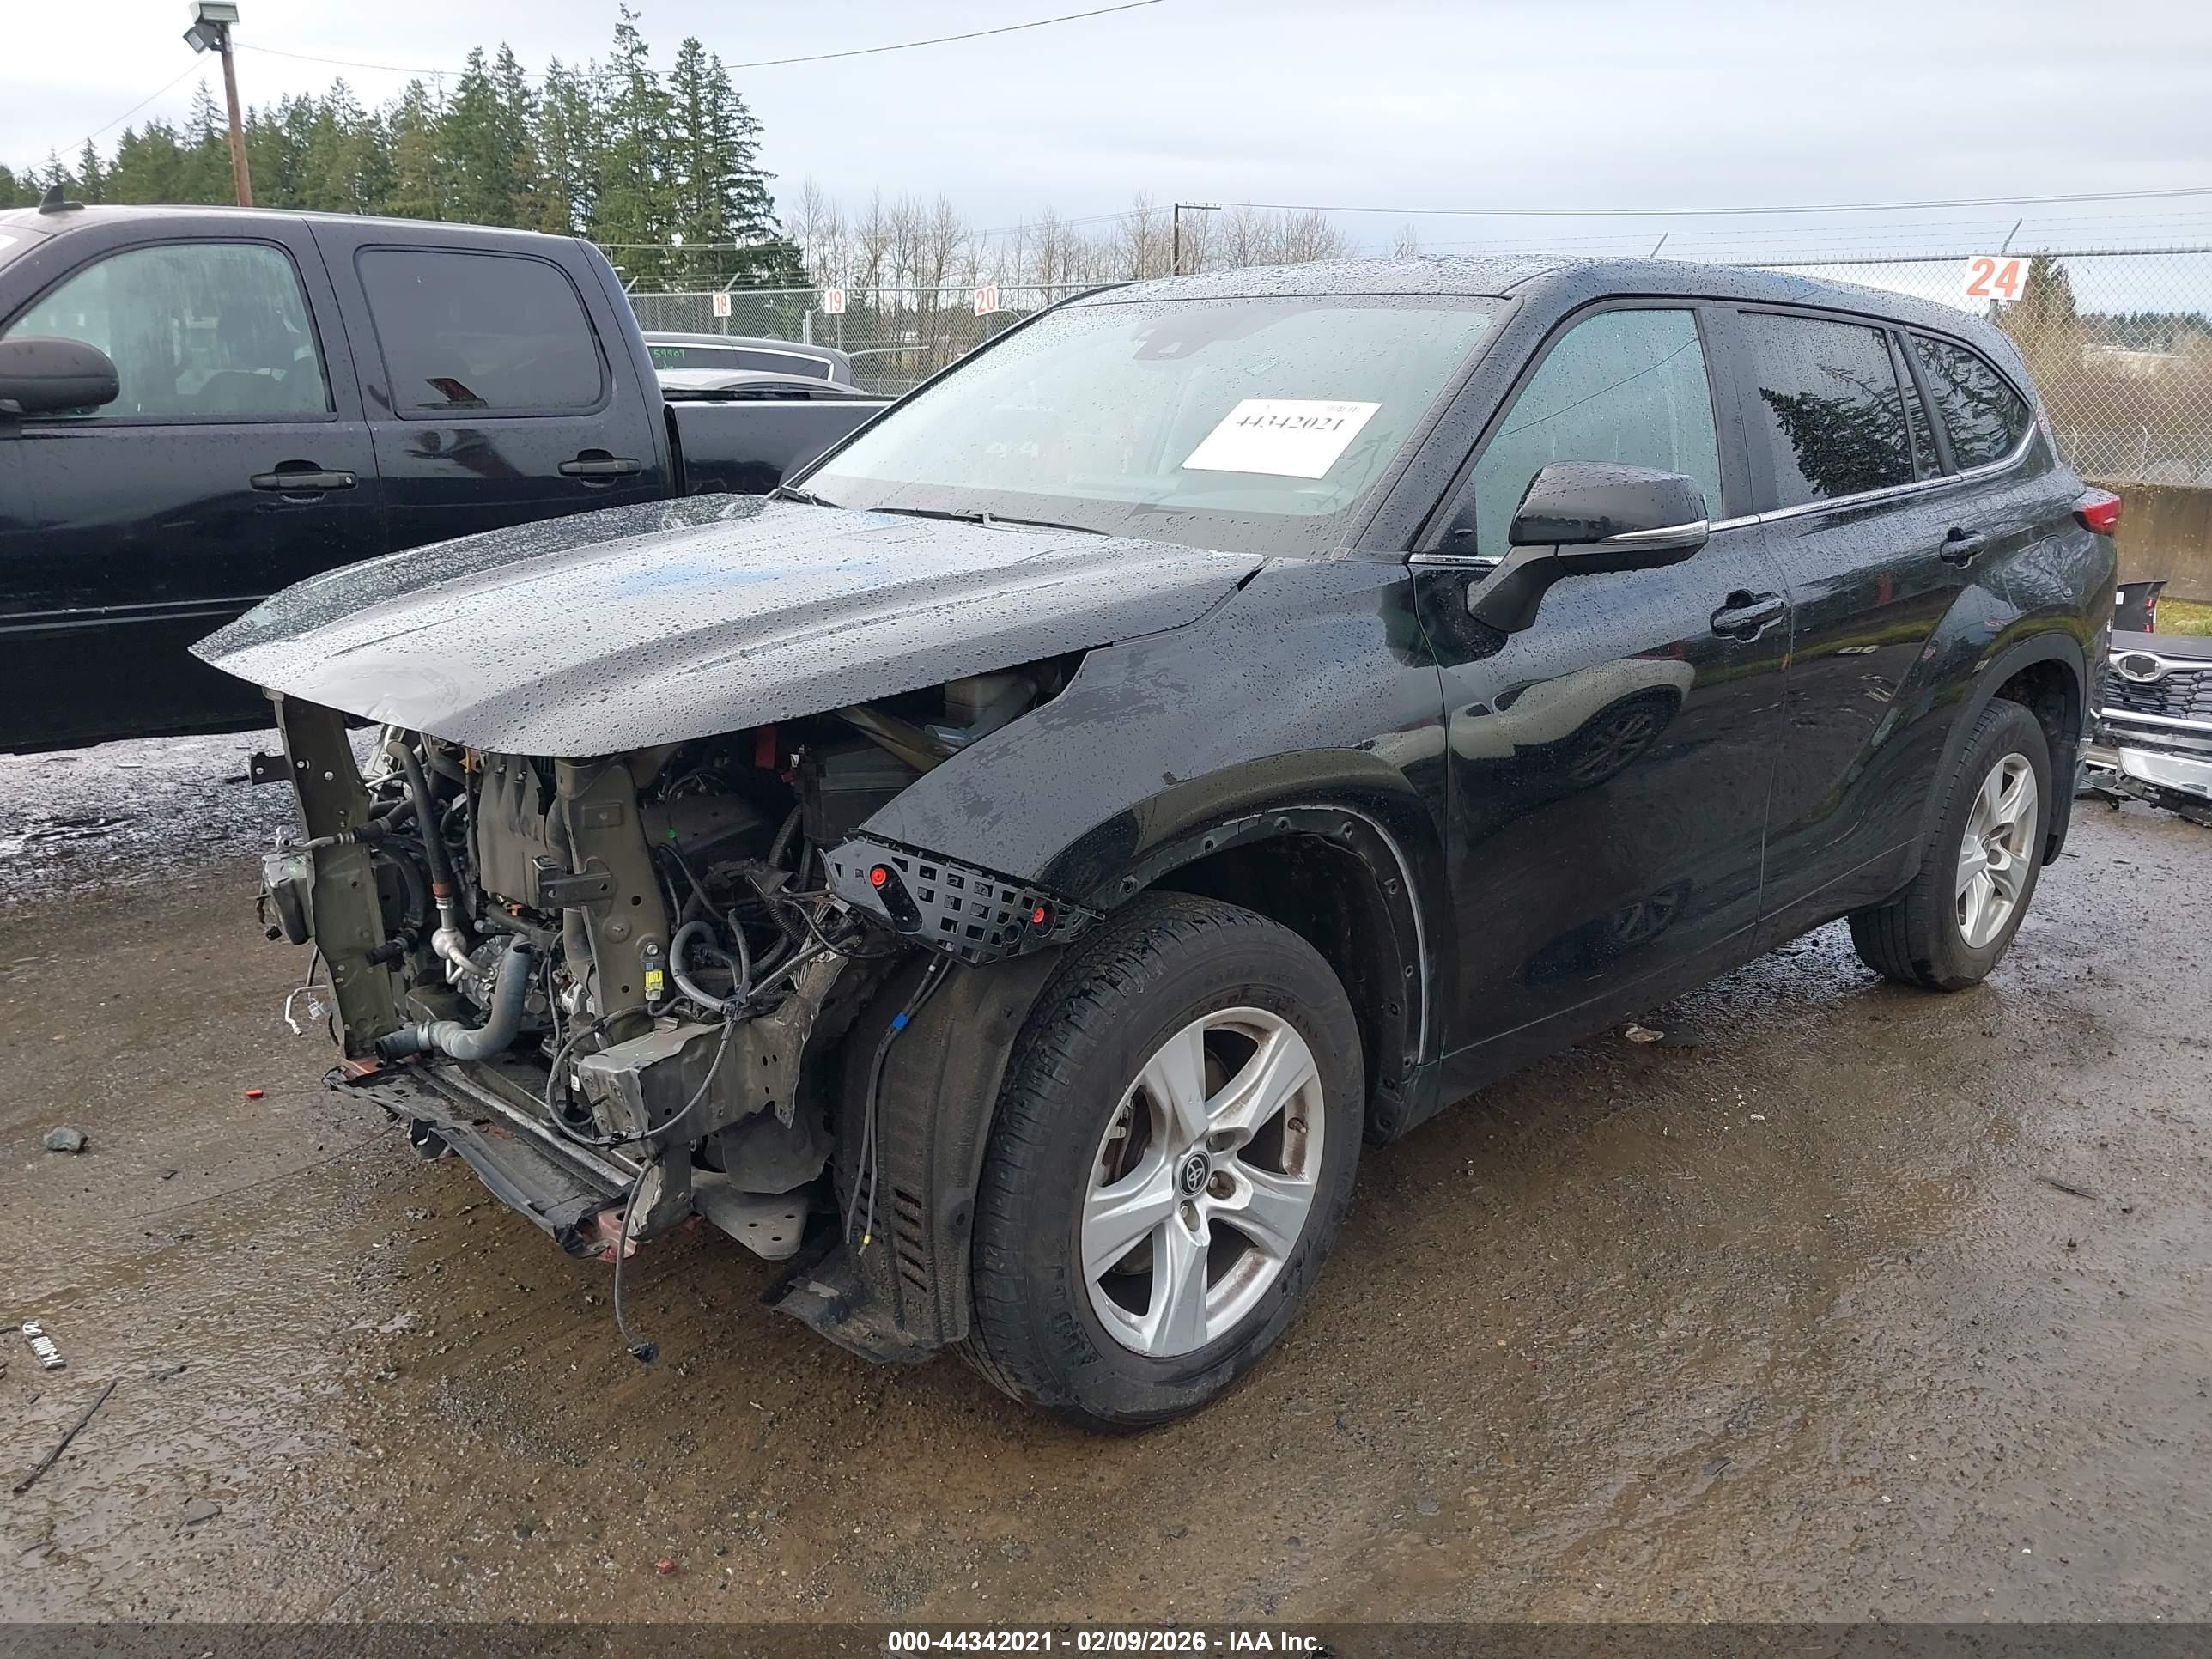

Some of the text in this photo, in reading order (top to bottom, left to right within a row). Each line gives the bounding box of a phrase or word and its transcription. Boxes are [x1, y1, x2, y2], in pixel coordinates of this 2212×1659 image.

[1966, 258, 2020, 298] 24
[716, 295, 727, 314] 18
[829, 291, 842, 311] 19
[976, 288, 995, 313] 20
[1236, 416, 1345, 431] 44342021
